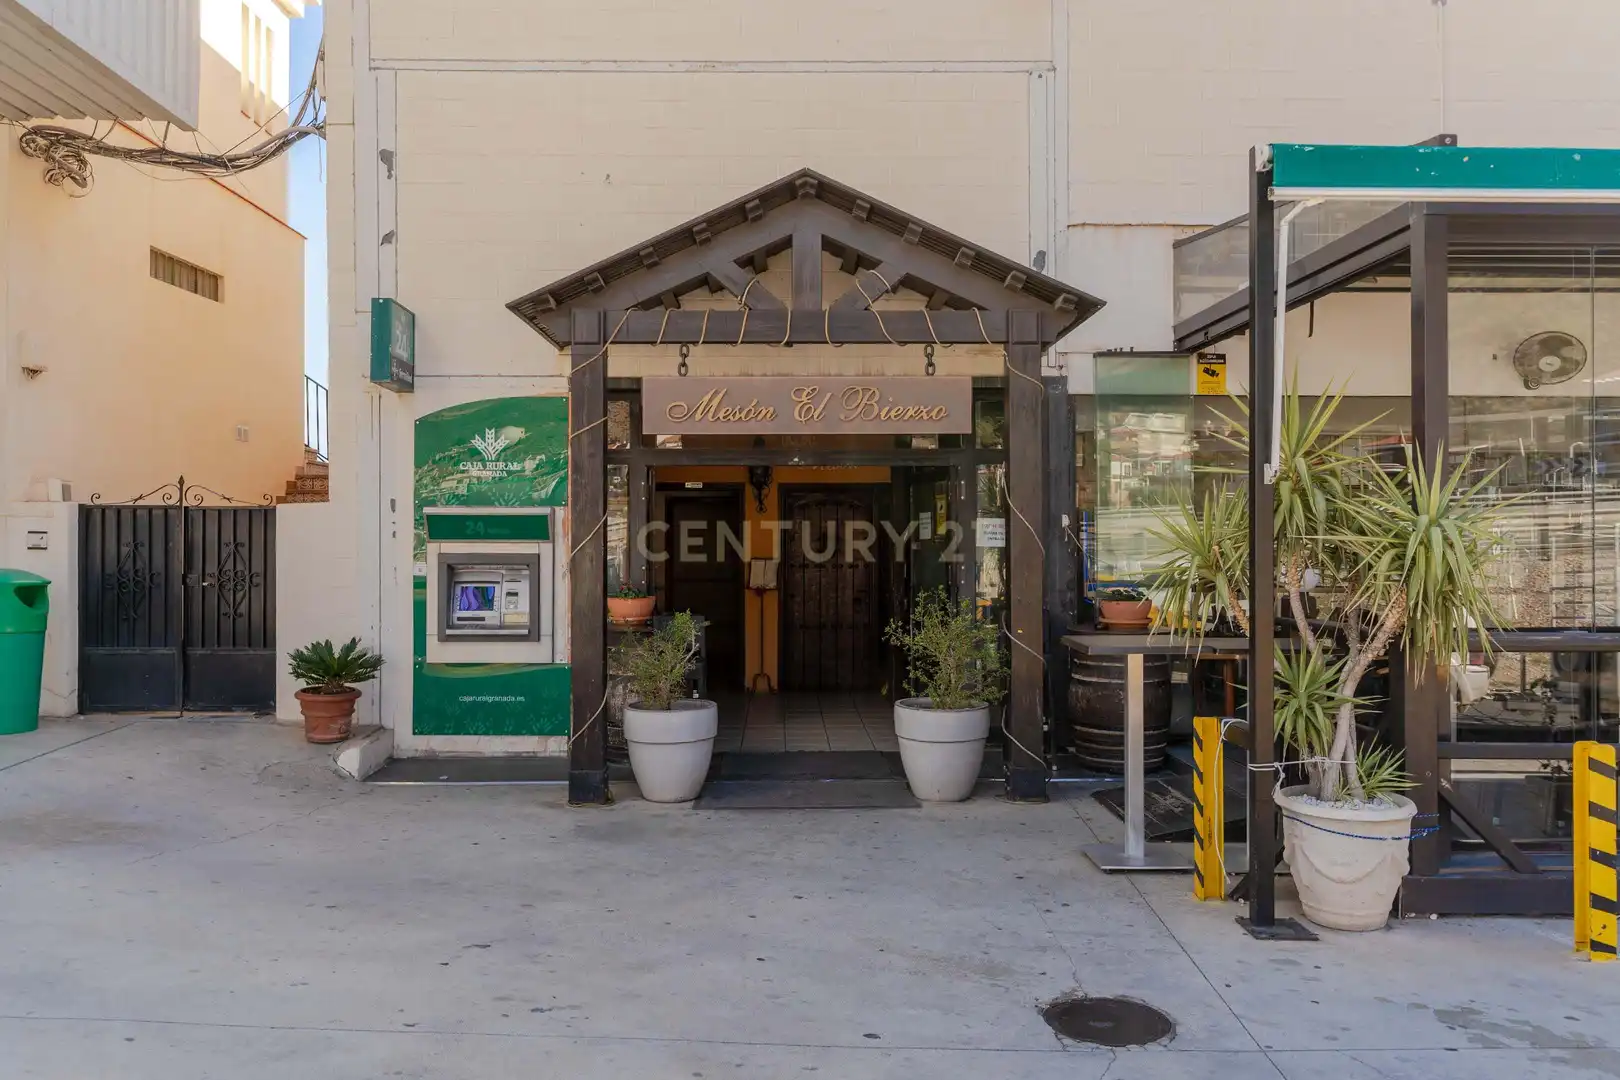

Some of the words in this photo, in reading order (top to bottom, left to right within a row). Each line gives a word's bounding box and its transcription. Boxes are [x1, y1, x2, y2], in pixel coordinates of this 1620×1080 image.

[666, 387, 778, 422] Mesón
[791, 385, 833, 424] El
[839, 385, 948, 422] Bierzo
[460, 462, 484, 470] CAJA
[486, 462, 520, 470] RURAL
[459, 695, 525, 703] cajaruralgranada.es
